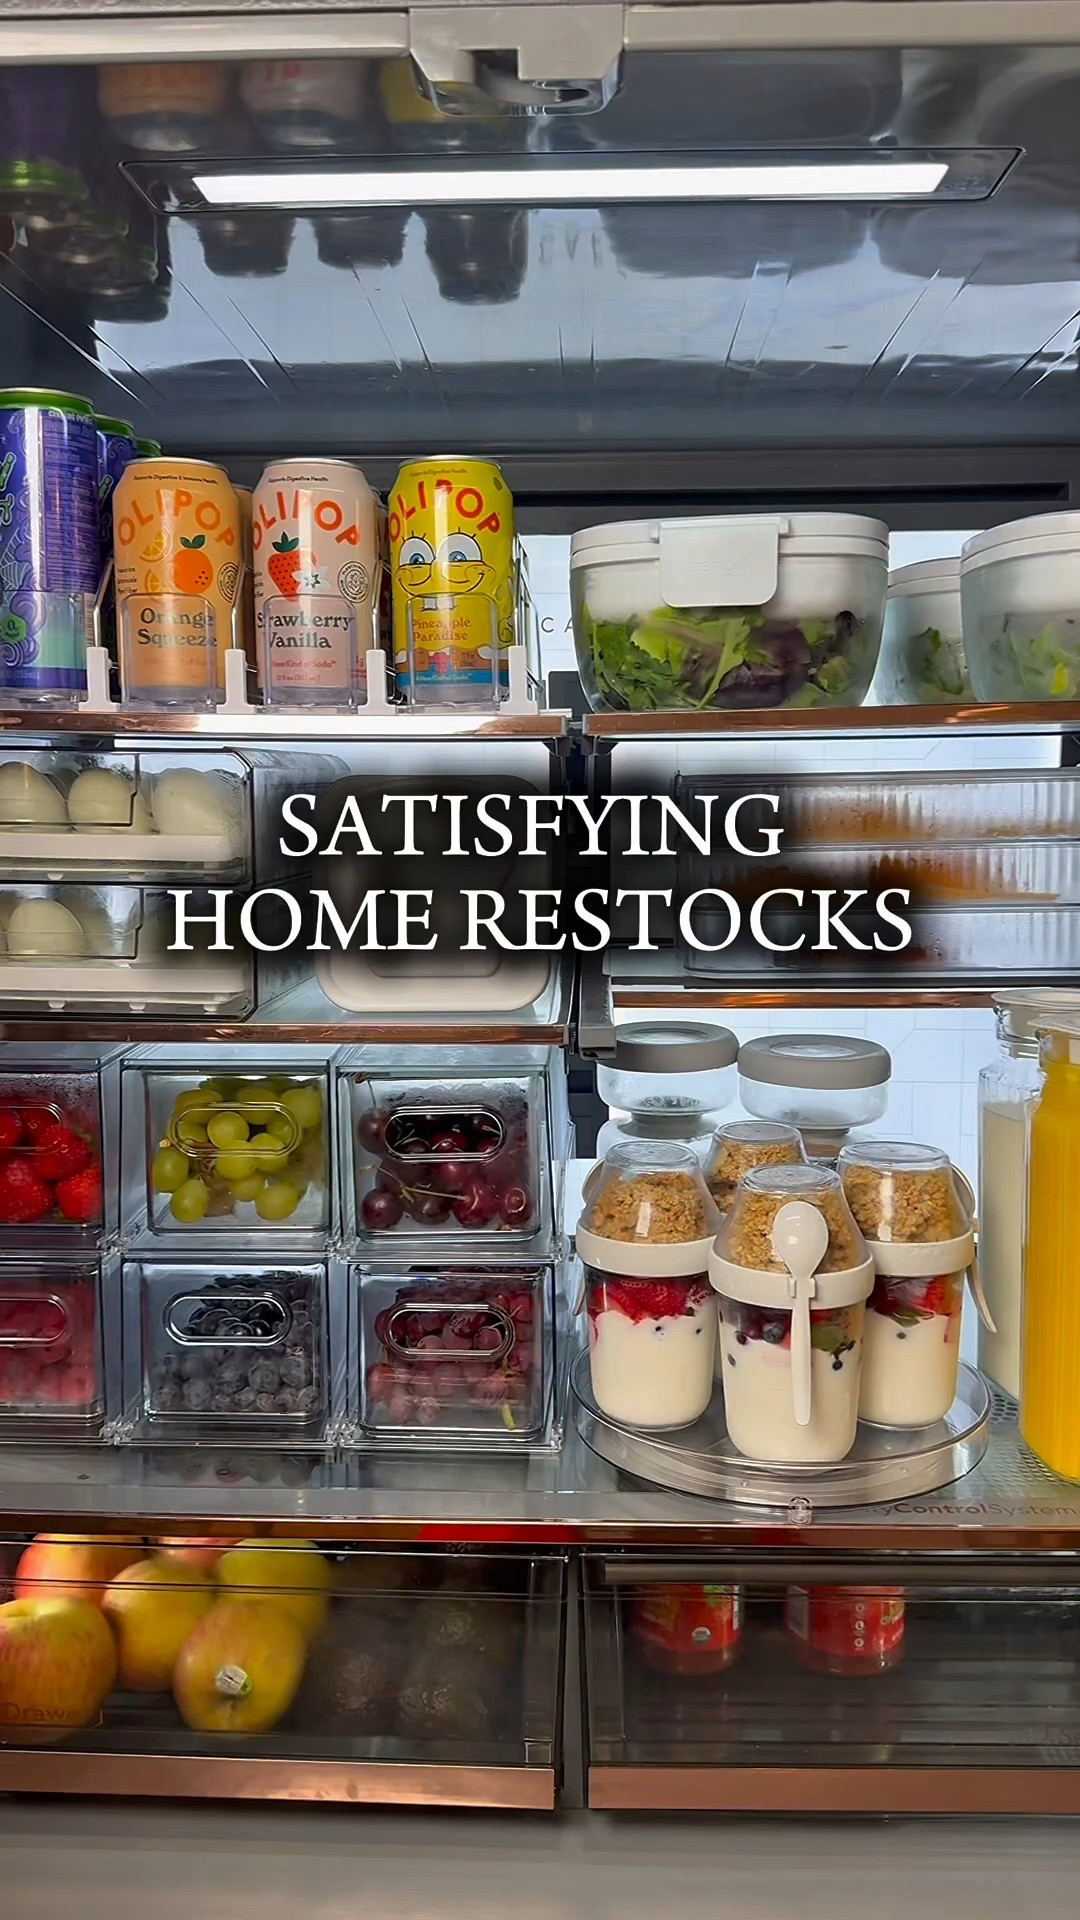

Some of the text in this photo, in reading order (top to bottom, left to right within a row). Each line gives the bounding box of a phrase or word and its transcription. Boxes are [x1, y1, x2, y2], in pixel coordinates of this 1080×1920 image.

[118, 488, 235, 547] OLIPOP
[140, 607, 214, 629] Orange
[257, 611, 355, 631] Srawberry
[137, 629, 218, 648] Squeeze
